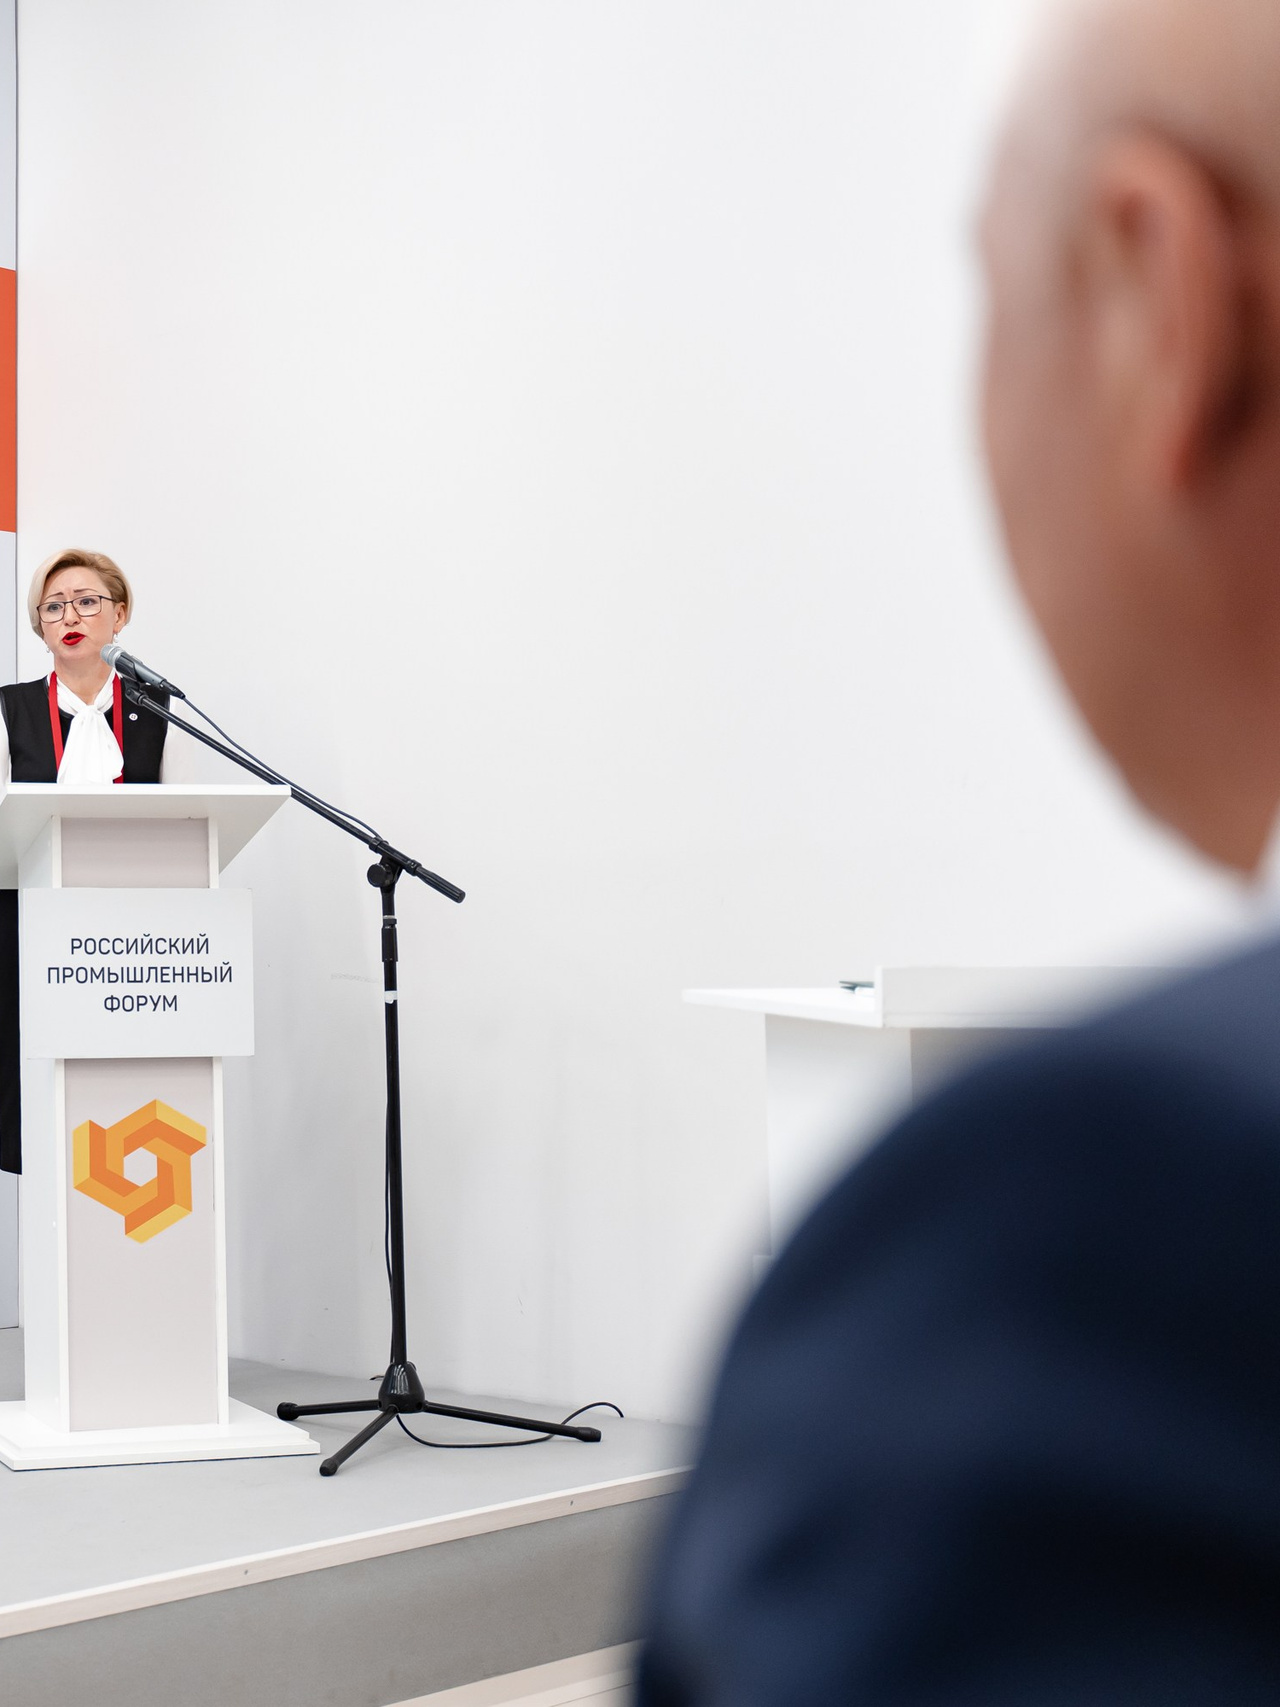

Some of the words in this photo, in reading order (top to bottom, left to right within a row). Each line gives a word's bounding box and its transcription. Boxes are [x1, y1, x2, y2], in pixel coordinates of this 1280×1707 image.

[70, 933, 209, 955] РОССИЙСКИЙ
[47, 961, 233, 984] ПРОМЫШЛЕННЫЙ
[103, 994, 178, 1013] ФОРУМ
